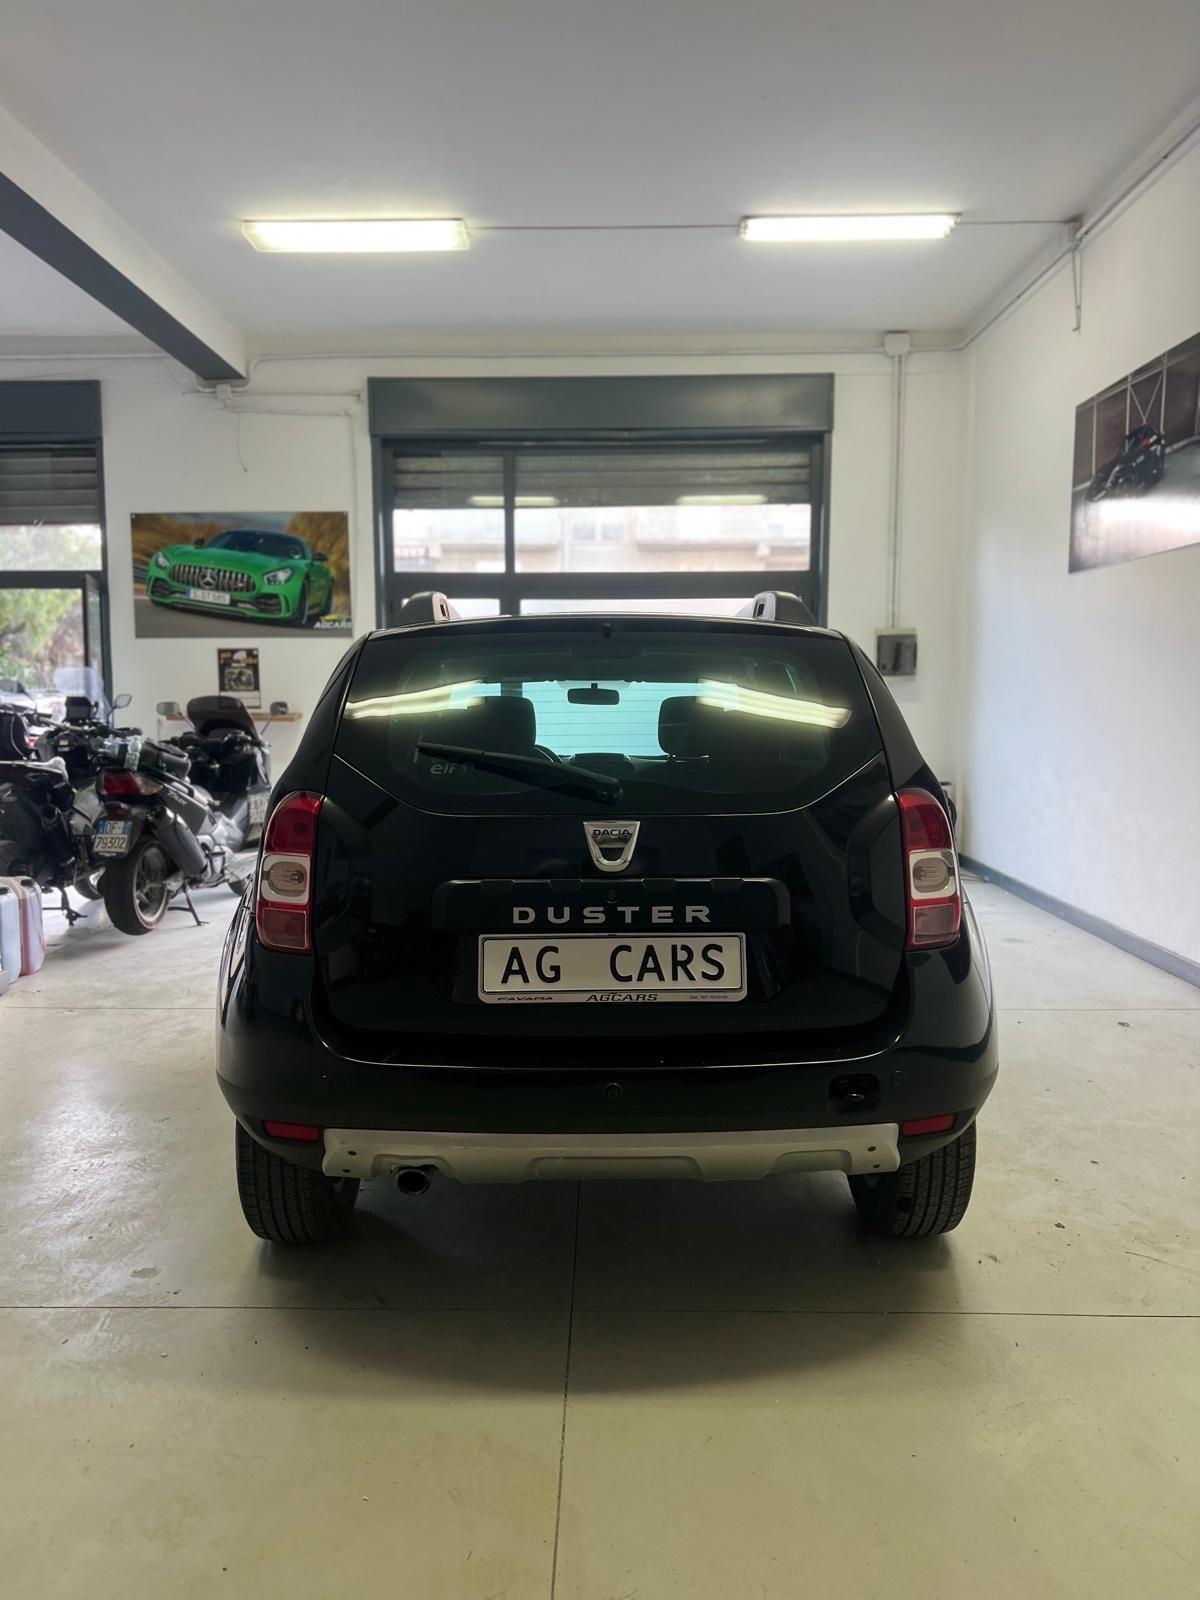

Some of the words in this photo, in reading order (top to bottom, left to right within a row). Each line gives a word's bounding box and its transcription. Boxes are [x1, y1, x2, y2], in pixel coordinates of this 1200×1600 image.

[512, 905, 712, 924] DUSTER
[501, 945, 561, 984] AG
[609, 943, 725, 983] CARS
[585, 994, 659, 1002] AGCARS
